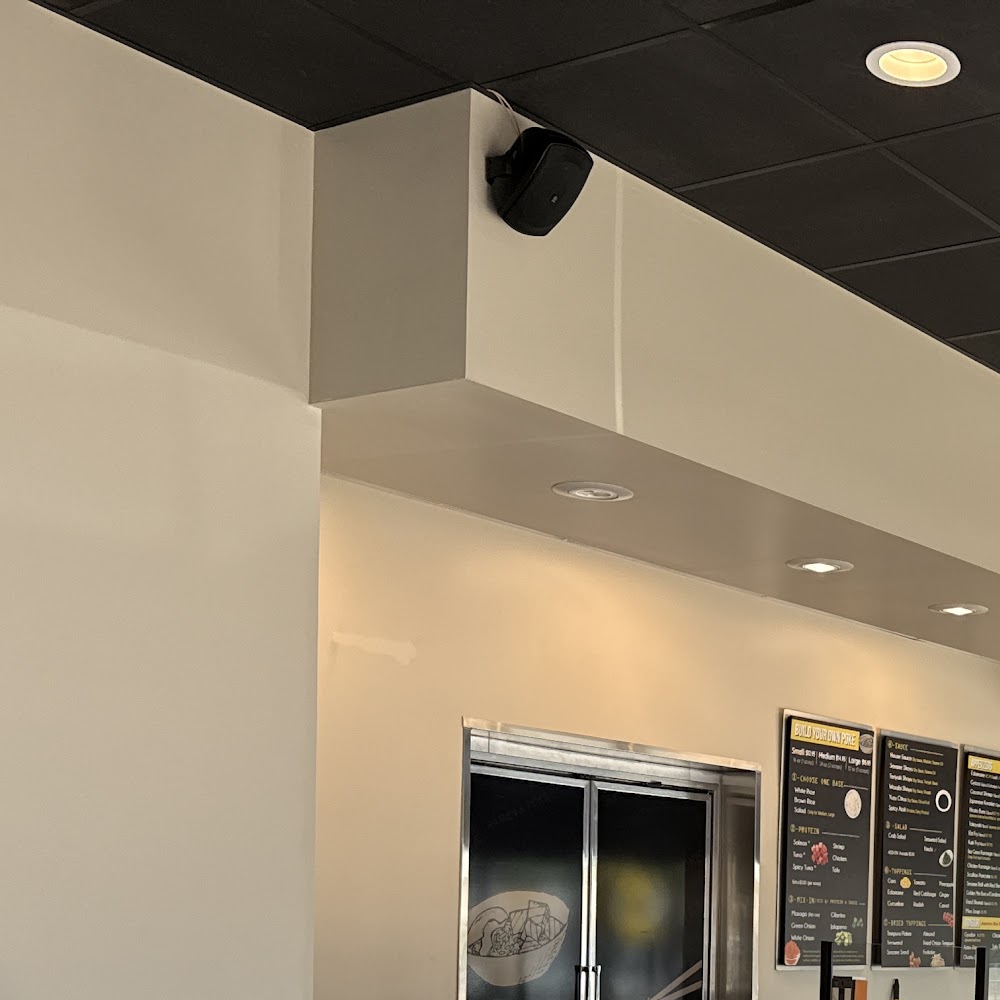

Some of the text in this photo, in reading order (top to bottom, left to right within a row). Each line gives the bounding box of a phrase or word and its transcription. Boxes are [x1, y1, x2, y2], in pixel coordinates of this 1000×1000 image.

[795, 723, 857, 748] BUILD YOUR OWN POKE
[791, 747, 805, 756] Small
[818, 752, 835, 761] Medium
[848, 756, 861, 766] Large
[832, 780, 844, 788] BASE
[794, 787, 806, 795] White
[794, 796, 816, 806] Brown Rice
[833, 843, 845, 851] Shrimp
[793, 851, 803, 859] Tuna
[792, 863, 814, 872] Spicy Tuna
[830, 911, 846, 919] Cilantro
[803, 934, 815, 942] Onion
